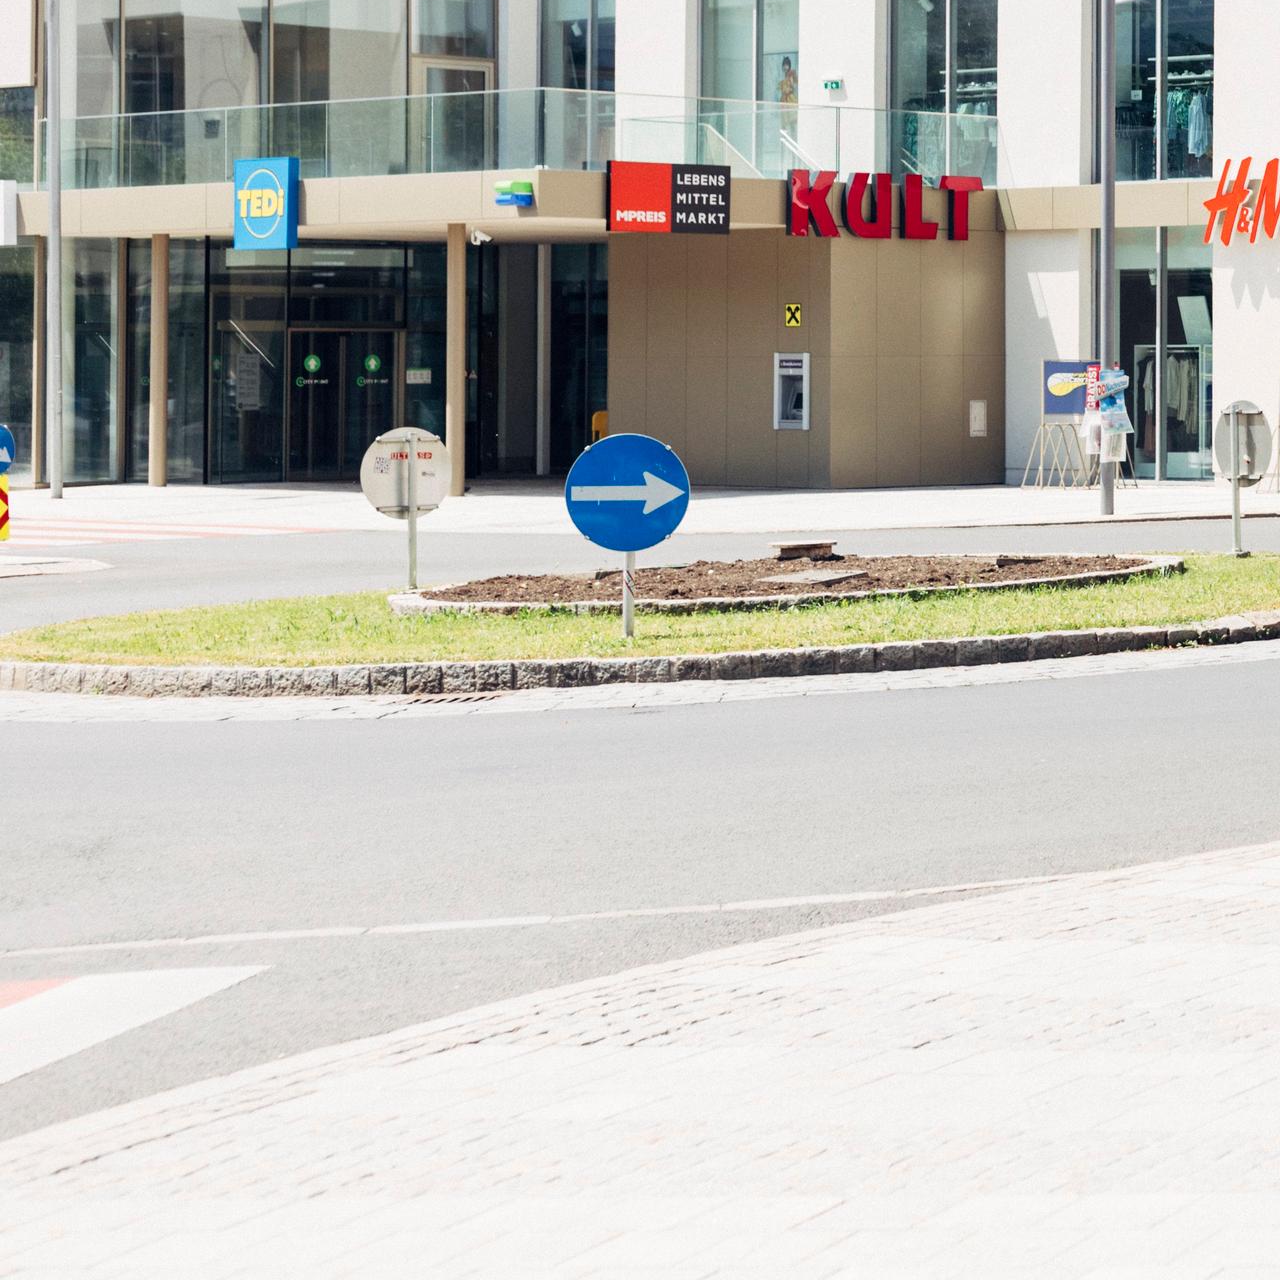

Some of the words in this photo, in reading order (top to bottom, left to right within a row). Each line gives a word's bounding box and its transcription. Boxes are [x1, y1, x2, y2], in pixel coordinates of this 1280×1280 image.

[676, 173, 726, 187] LEBENS
[237, 188, 285, 219] TEDi
[676, 193, 726, 206] MITTEL
[786, 168, 985, 241] KULT
[616, 210, 667, 223] MPREIS
[676, 212, 726, 225] MARKT
